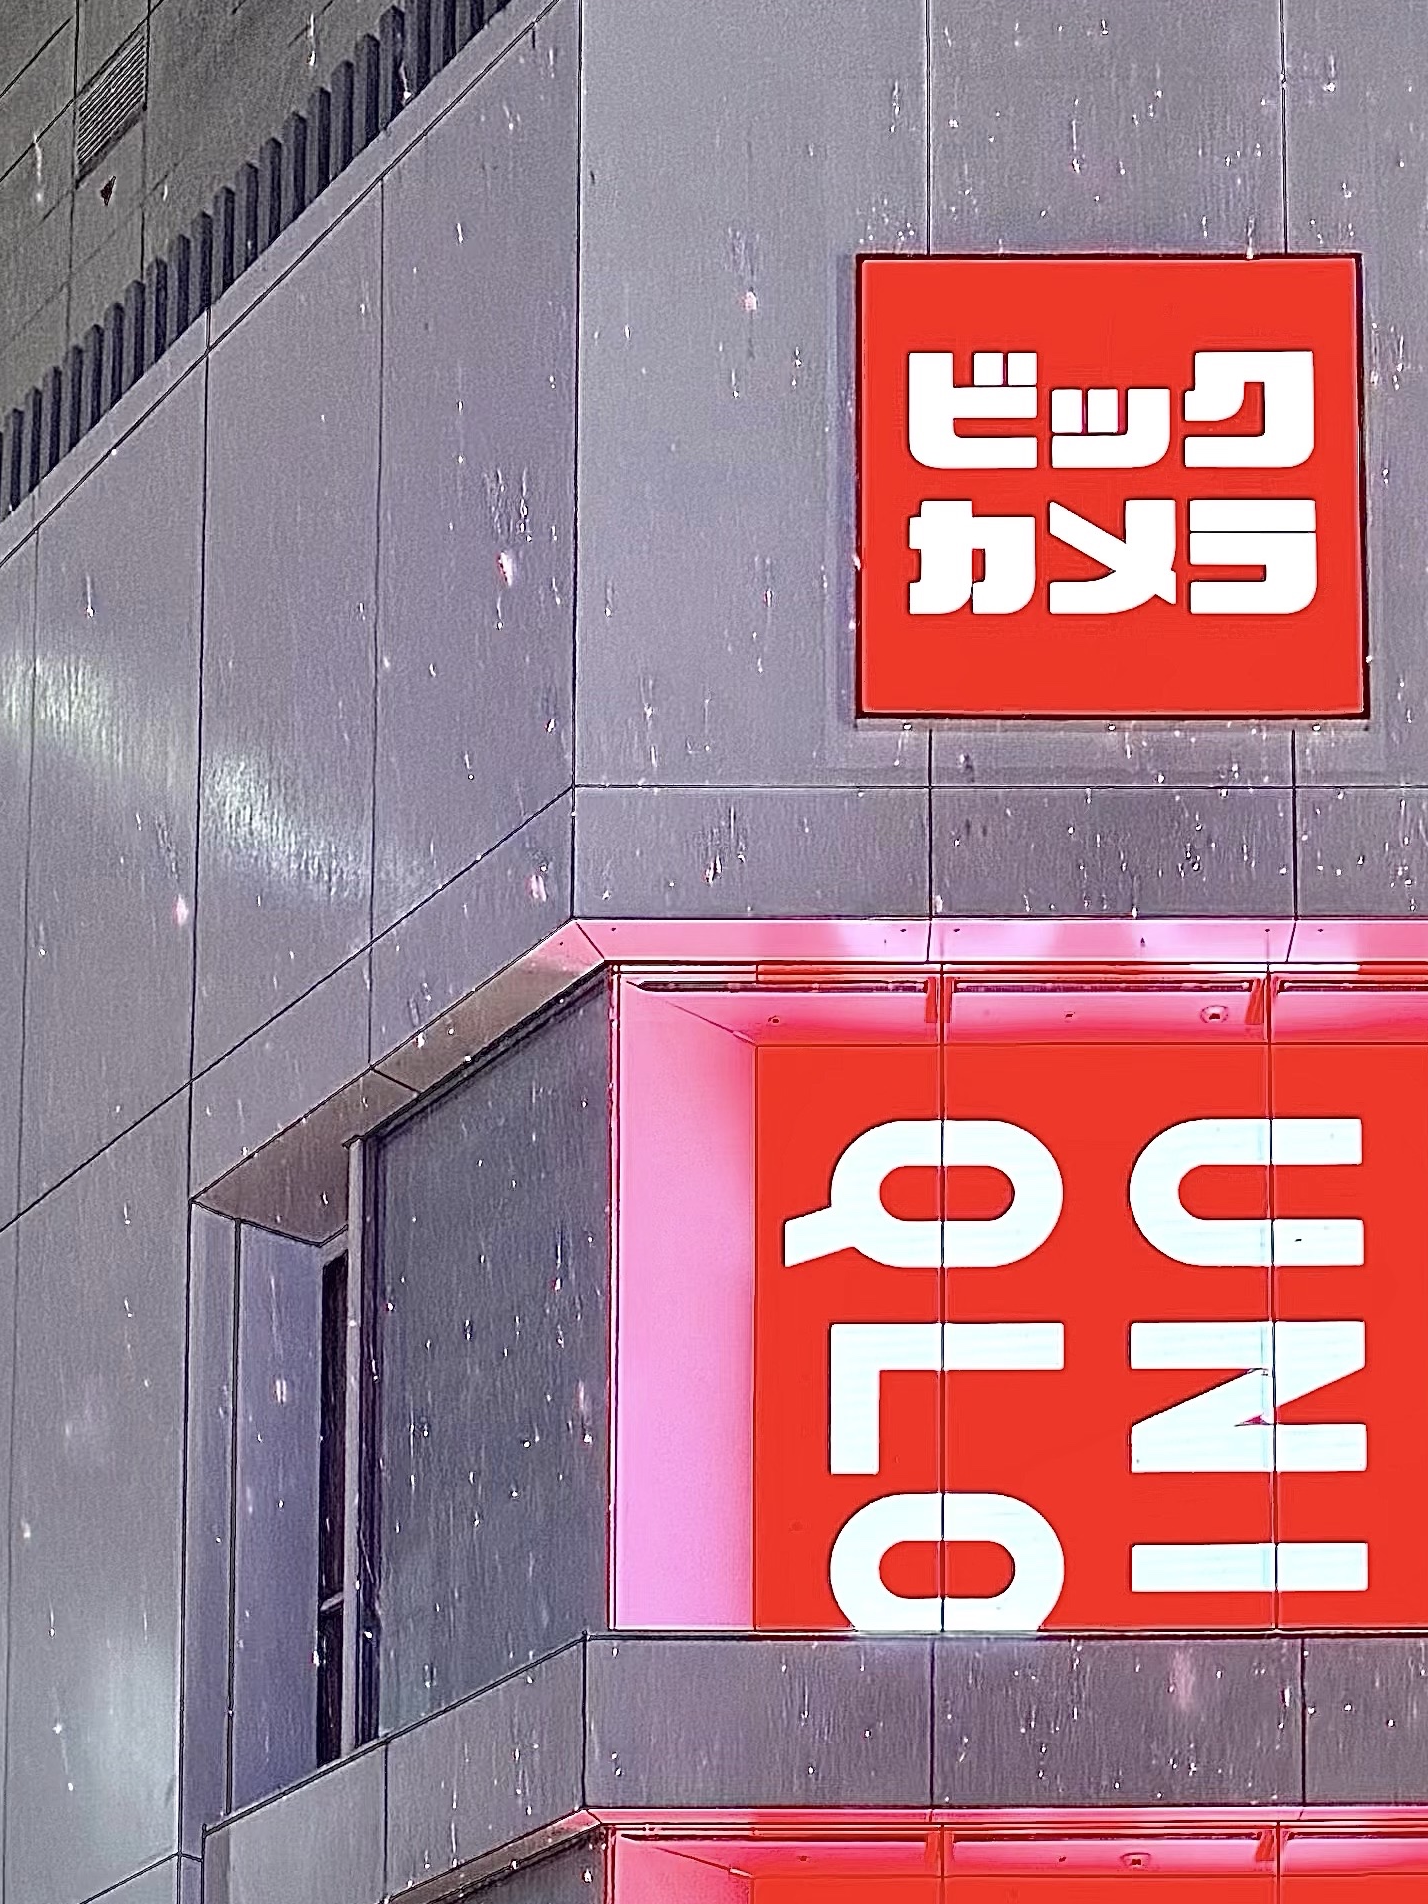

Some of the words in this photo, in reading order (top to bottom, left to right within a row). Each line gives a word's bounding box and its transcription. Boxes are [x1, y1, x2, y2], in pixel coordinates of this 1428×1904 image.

[908, 350, 1315, 469] ビック
[908, 499, 1318, 615] カメラ
[783, 1118, 1066, 1632] QLO
[1128, 1117, 1370, 1593] UNI
